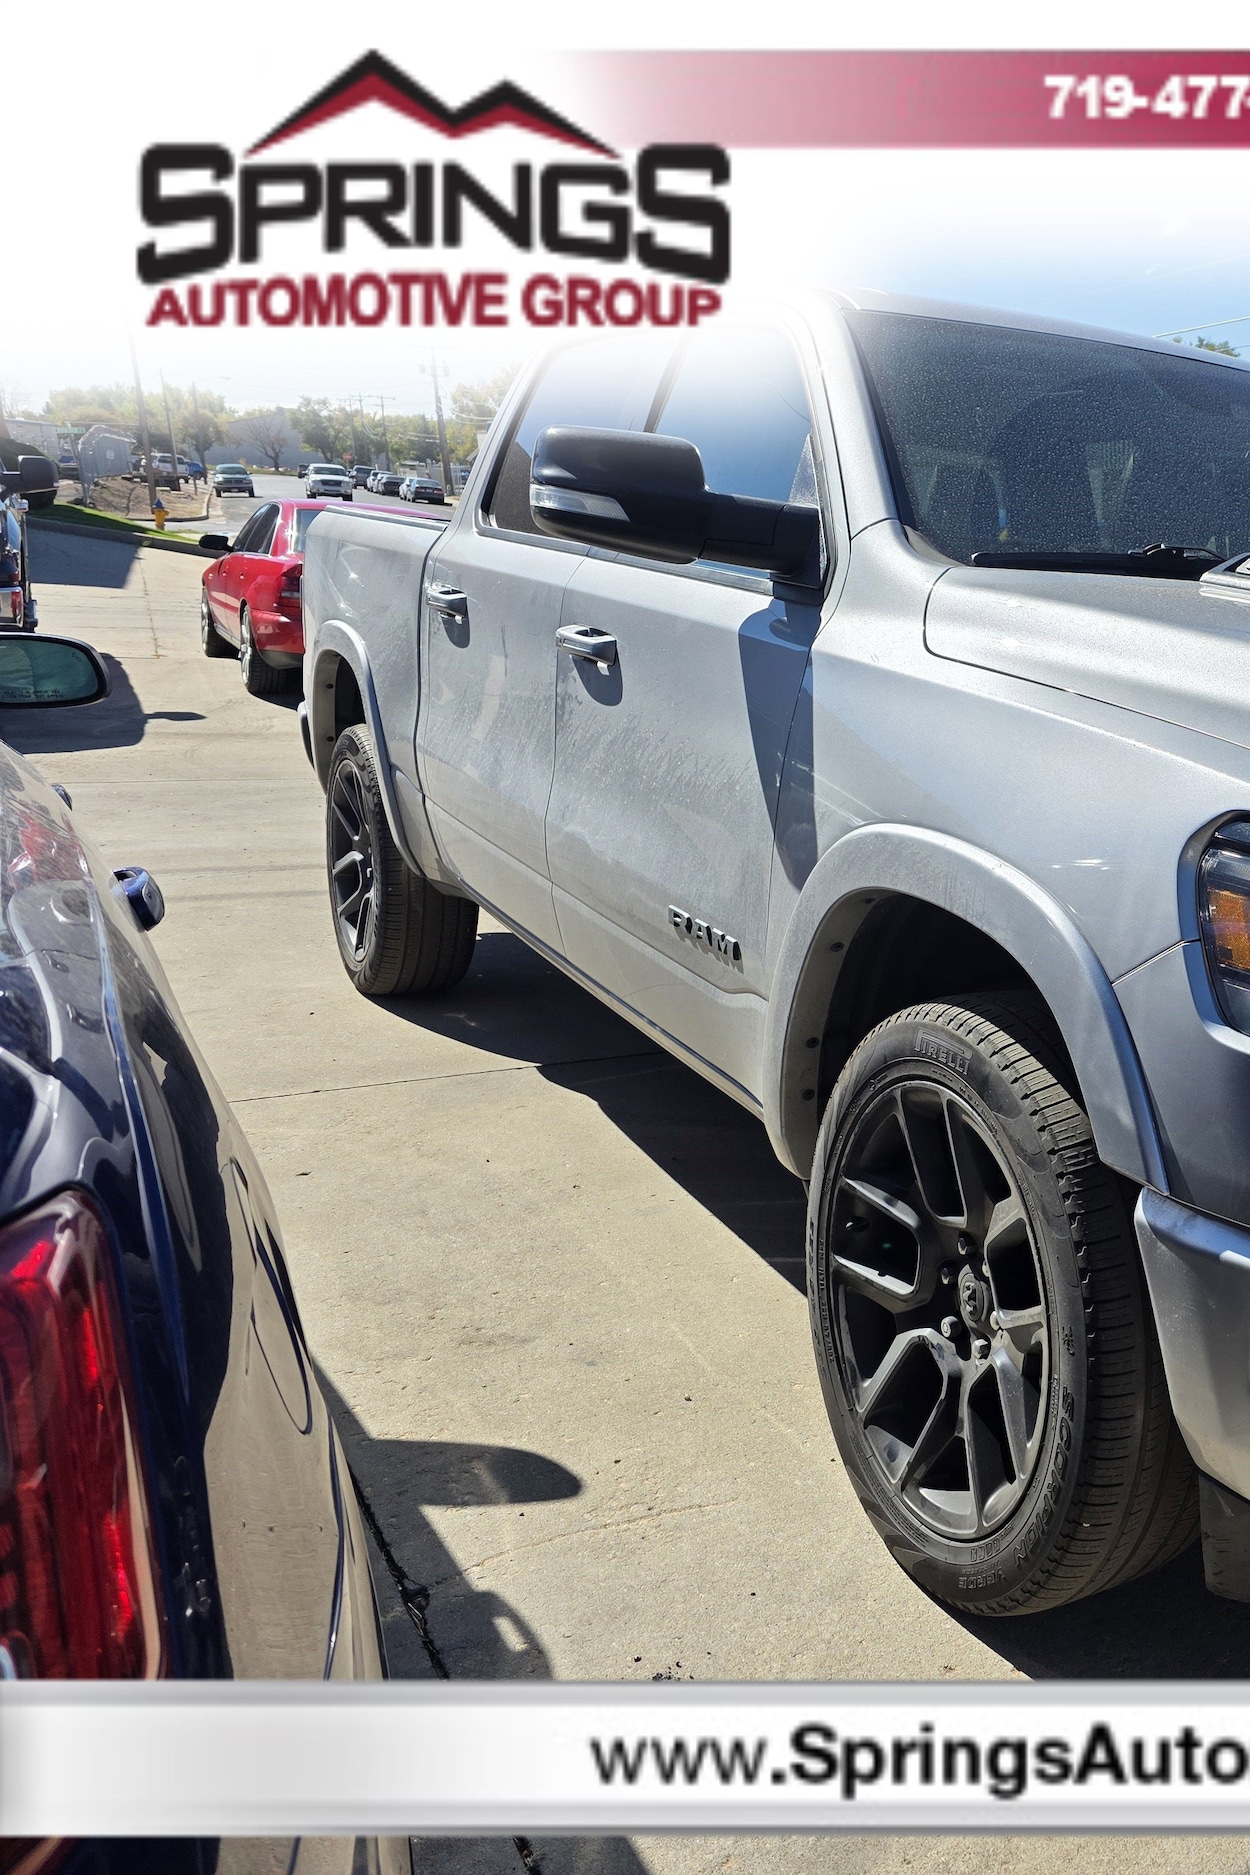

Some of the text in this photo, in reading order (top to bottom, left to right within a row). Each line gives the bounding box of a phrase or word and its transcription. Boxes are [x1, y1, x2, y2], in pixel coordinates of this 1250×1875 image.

[667, 904, 742, 961] RAM
[914, 1027, 974, 1076] PIRELLI
[1013, 1385, 1075, 1568] SCORPION
[958, 1565, 1005, 1589] VERDE
